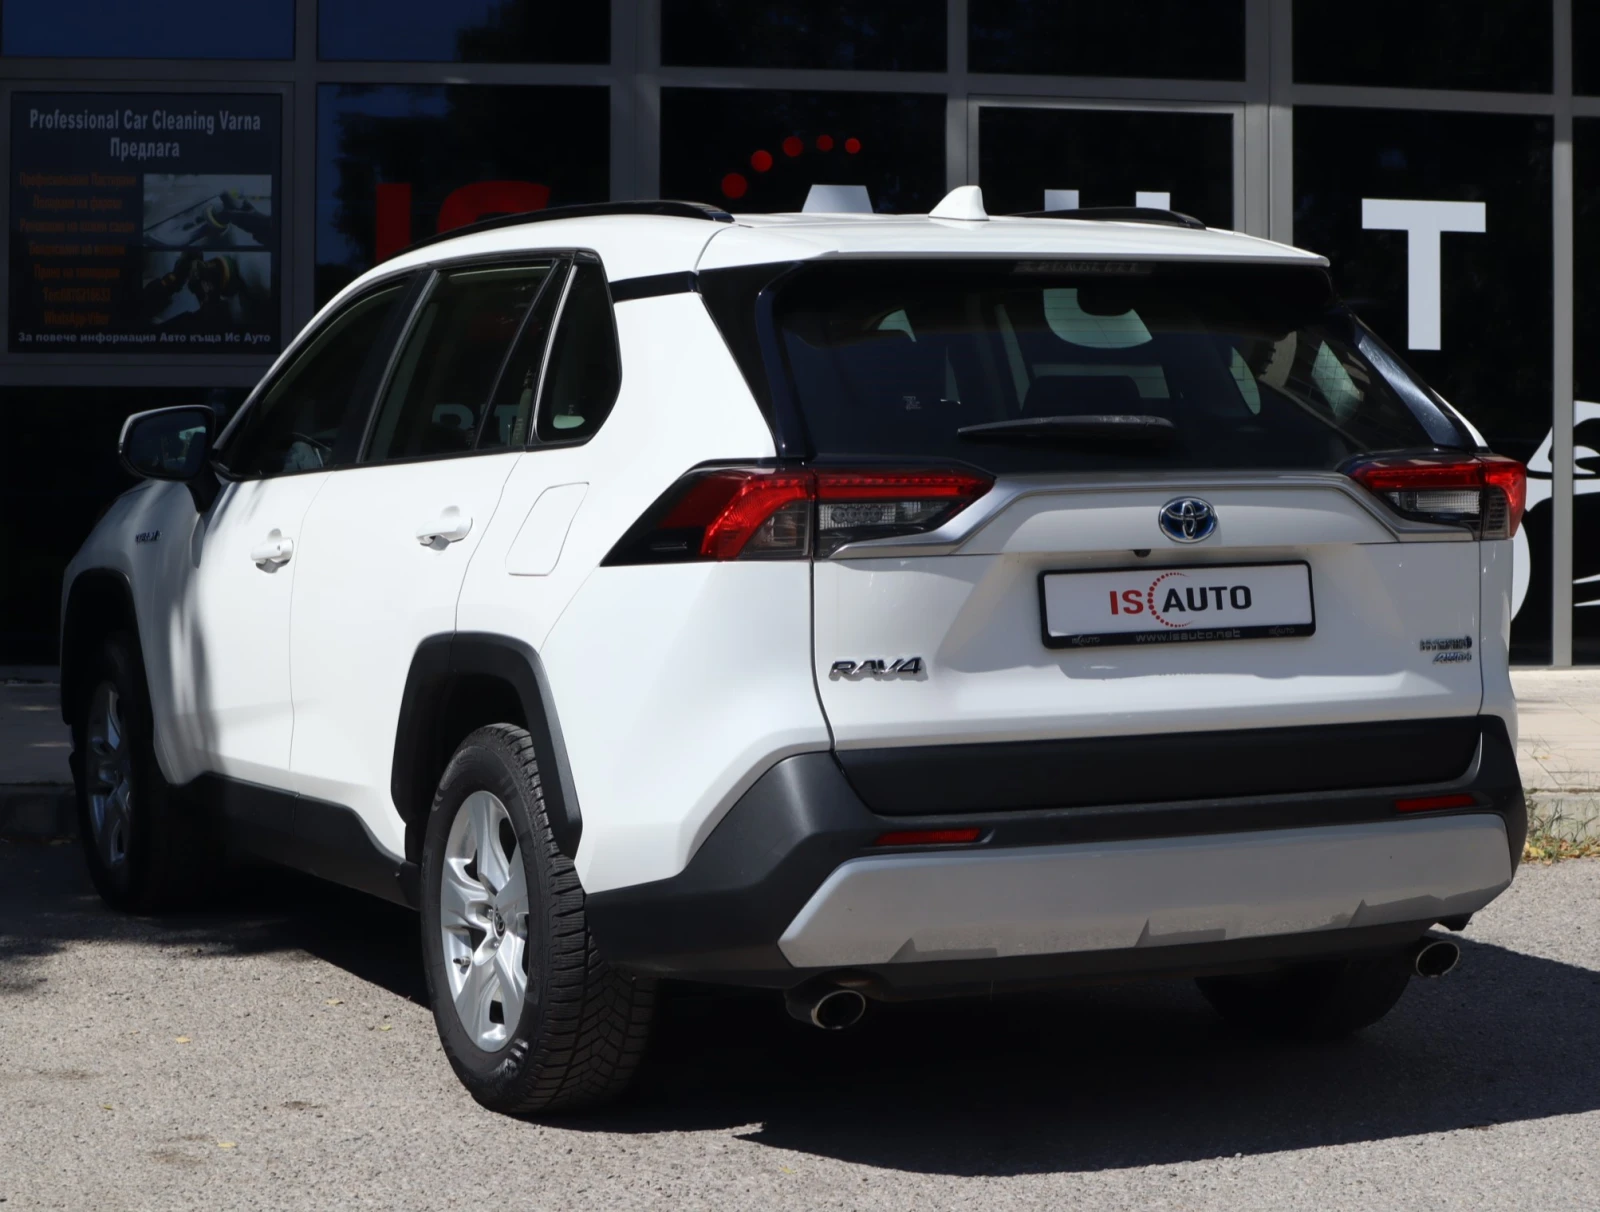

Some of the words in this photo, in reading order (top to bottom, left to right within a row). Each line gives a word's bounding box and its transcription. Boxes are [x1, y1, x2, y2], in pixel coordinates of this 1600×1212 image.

[30, 109, 119, 130] Professional
[123, 110, 148, 130] Car
[152, 110, 215, 135] Cleaning
[219, 110, 261, 131] Varna
[110, 137, 180, 161] Предлага
[18, 332, 32, 342] За
[35, 334, 77, 342] повече
[80, 332, 156, 345] информация
[160, 332, 187, 342] Авто
[190, 333, 221, 344] къща
[225, 332, 240, 342] Ис
[244, 332, 271, 344] Ауто
[1109, 589, 1144, 615] IS
[1162, 585, 1252, 613] AUTO
[1135, 629, 1241, 642] www.isauto.net
[831, 656, 923, 676] RAV4
